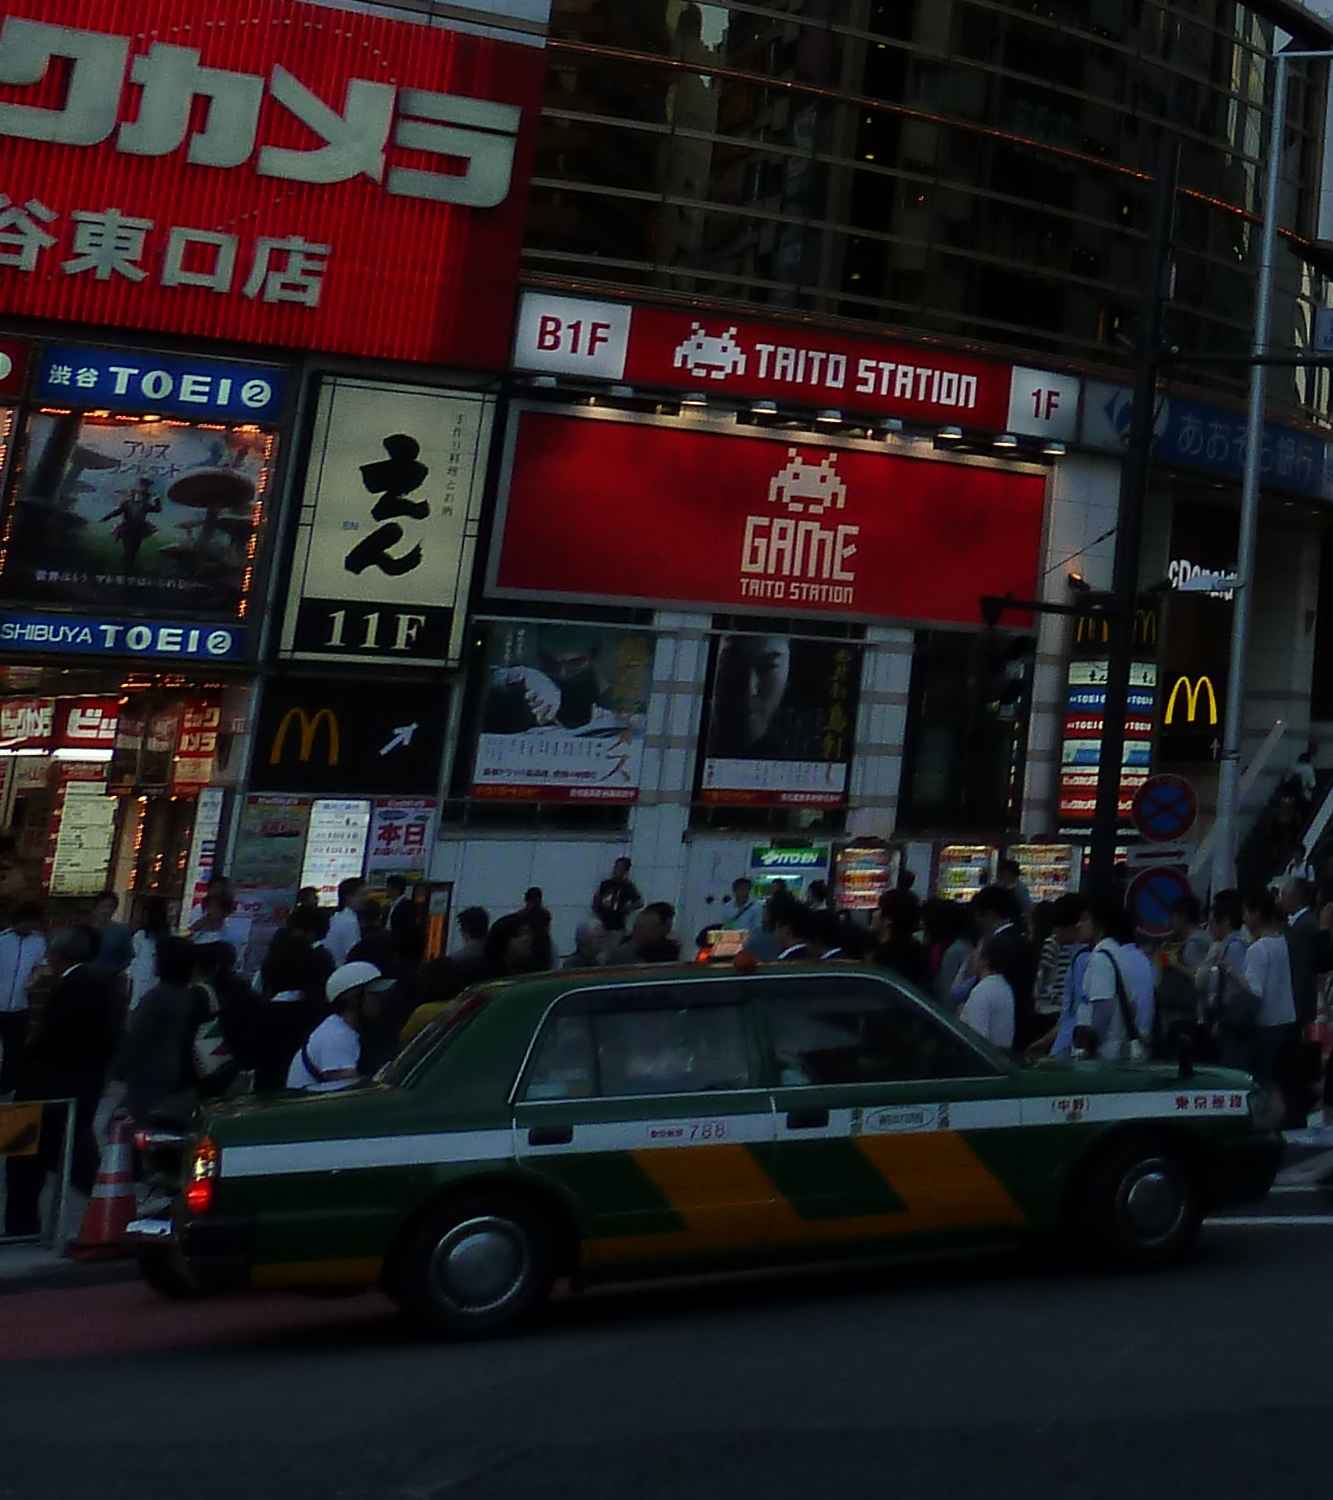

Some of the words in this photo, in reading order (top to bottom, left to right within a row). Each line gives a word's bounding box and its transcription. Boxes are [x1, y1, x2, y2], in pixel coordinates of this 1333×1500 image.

[538, 315, 611, 359] B1F
[48, 363, 98, 389] 渋谷
[754, 343, 848, 389] TAITO
[855, 359, 978, 408] STATION
[1030, 389, 1061, 420] 1F
[345, 434, 431, 576] えん
[739, 515, 860, 582] GAME
[739, 578, 785, 599] TAITO
[789, 581, 854, 604] STATION
[0, 621, 94, 646] SHIBUYA
[325, 608, 428, 651] 11F
[378, 823, 426, 846] 本日
[1175, 1094, 1242, 1111] 東京無線
[690, 1121, 726, 1140] 788
